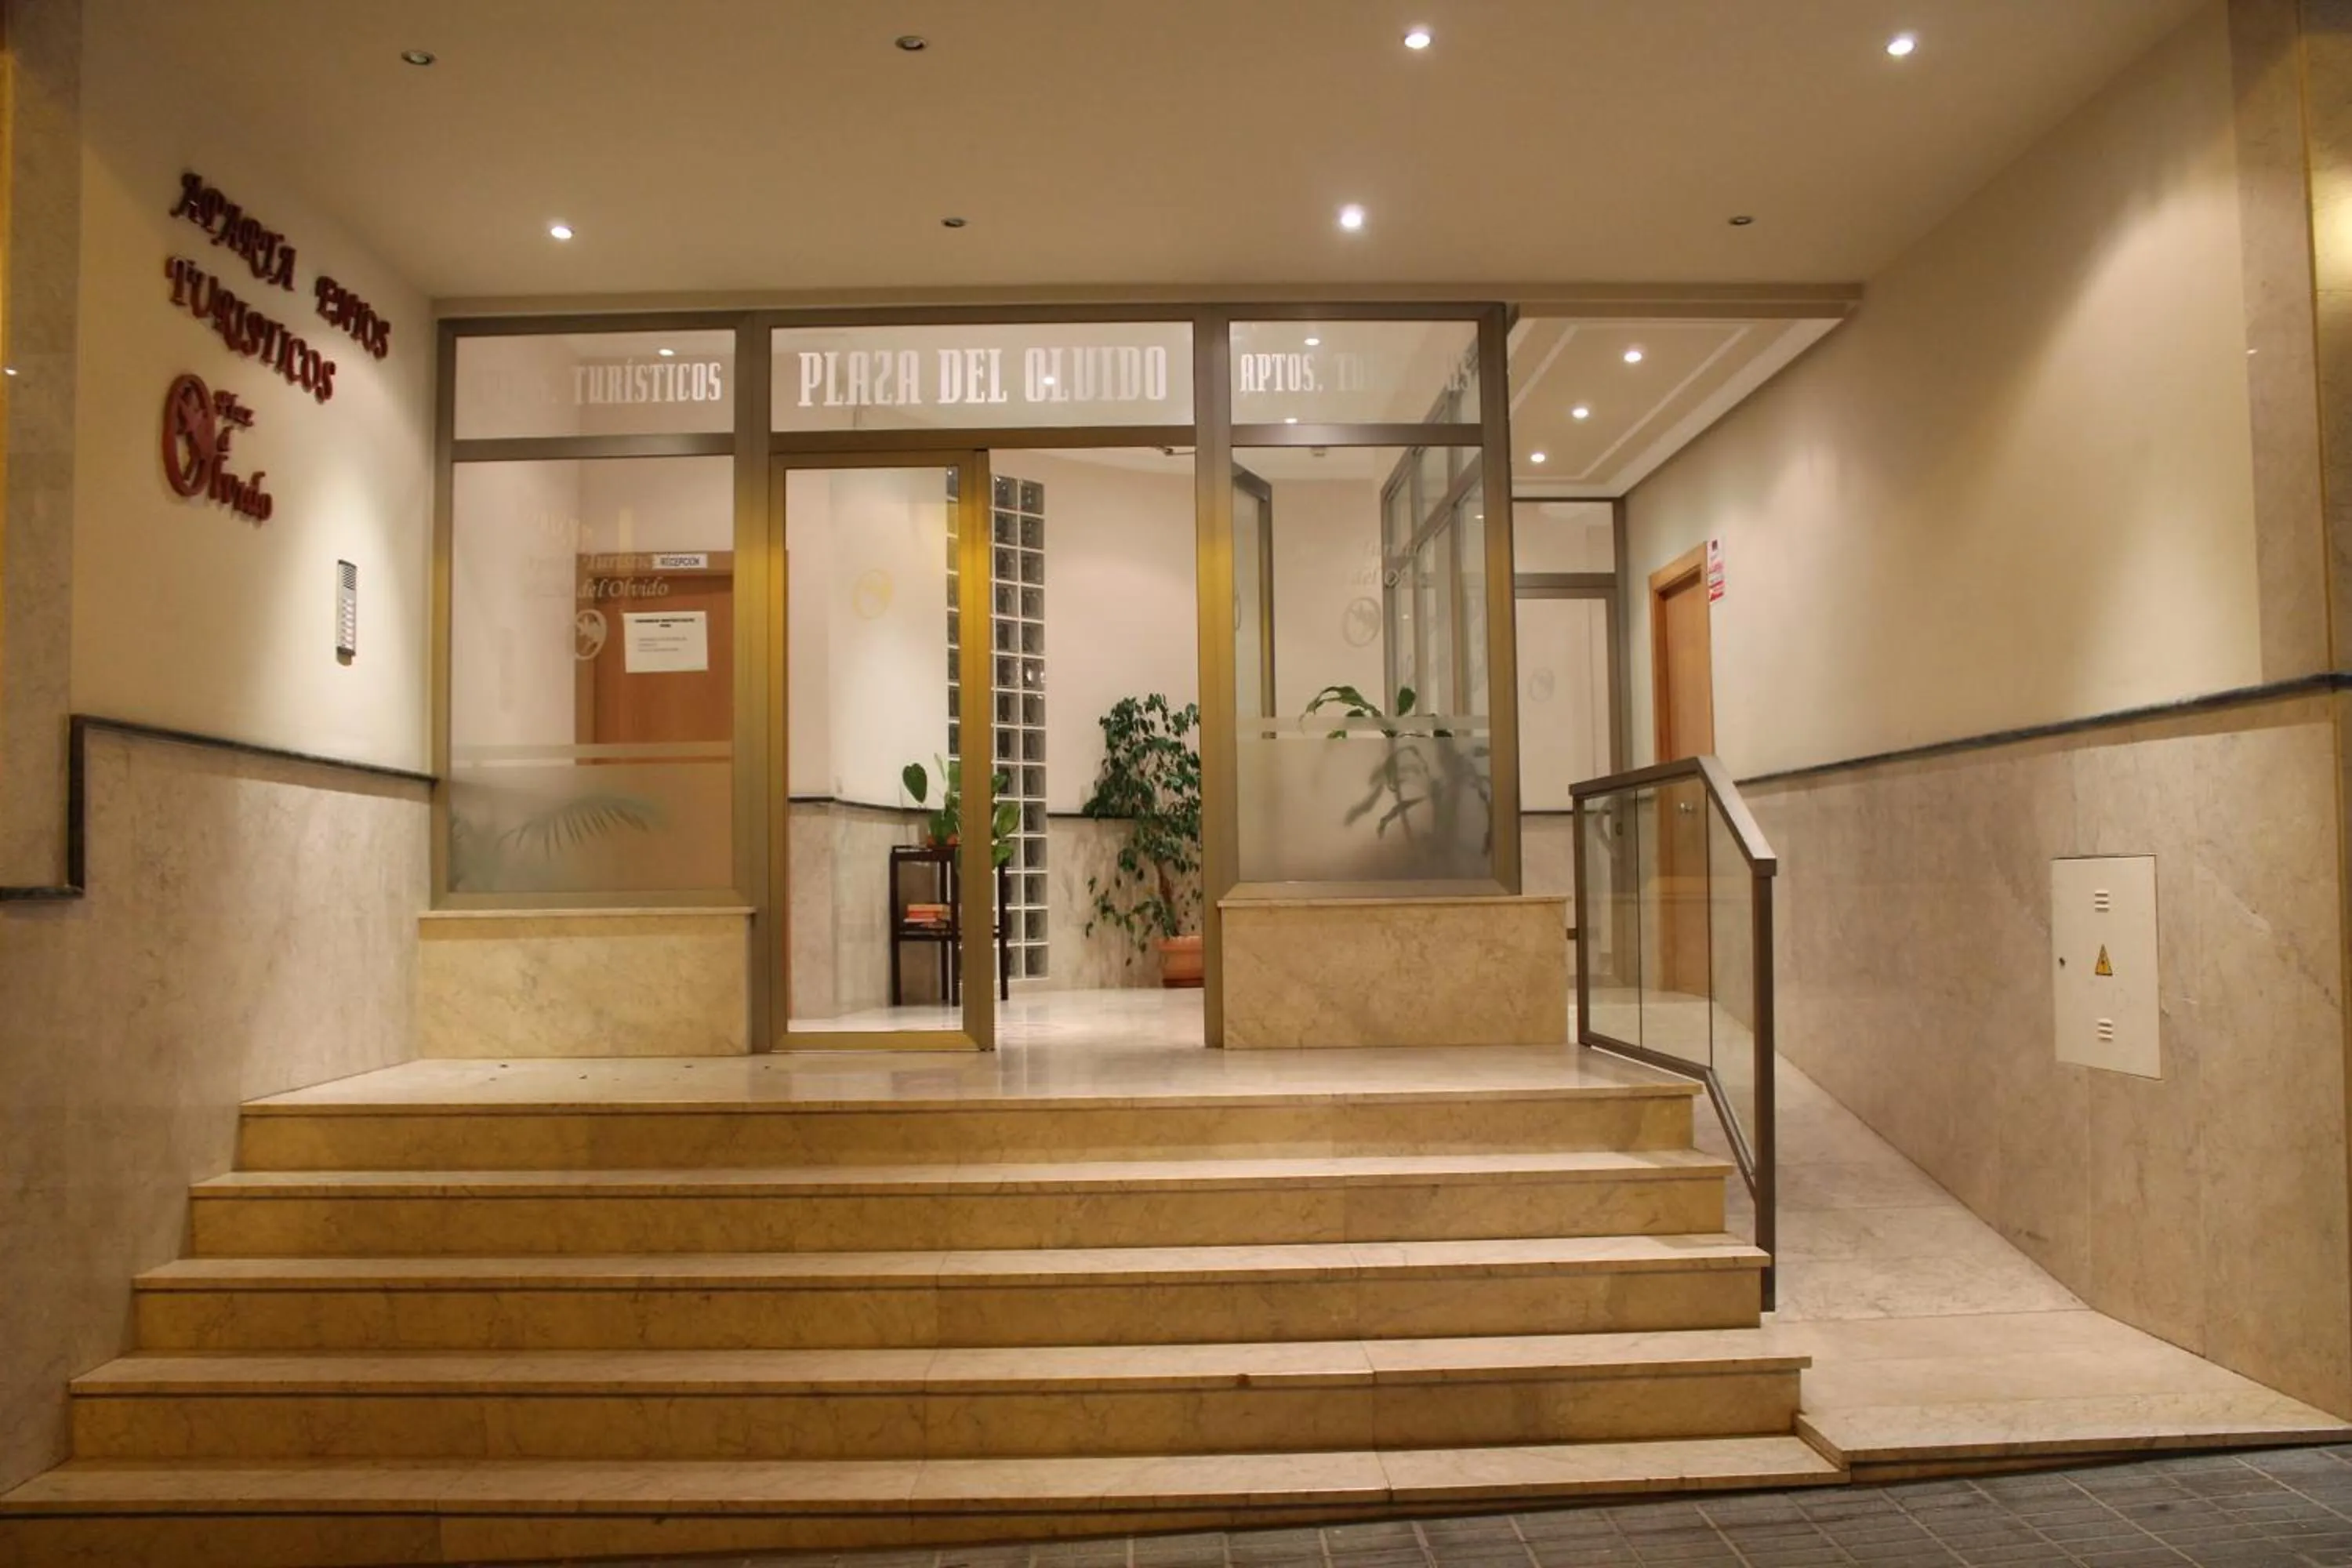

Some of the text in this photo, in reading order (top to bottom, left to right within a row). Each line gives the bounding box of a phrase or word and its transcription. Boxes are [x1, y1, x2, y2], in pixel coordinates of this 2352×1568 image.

[573, 358, 722, 405] TURÍSTICOS
[797, 350, 922, 406] PLAZA
[937, 348, 1007, 404] DEL
[608, 576, 670, 598] Olvido
